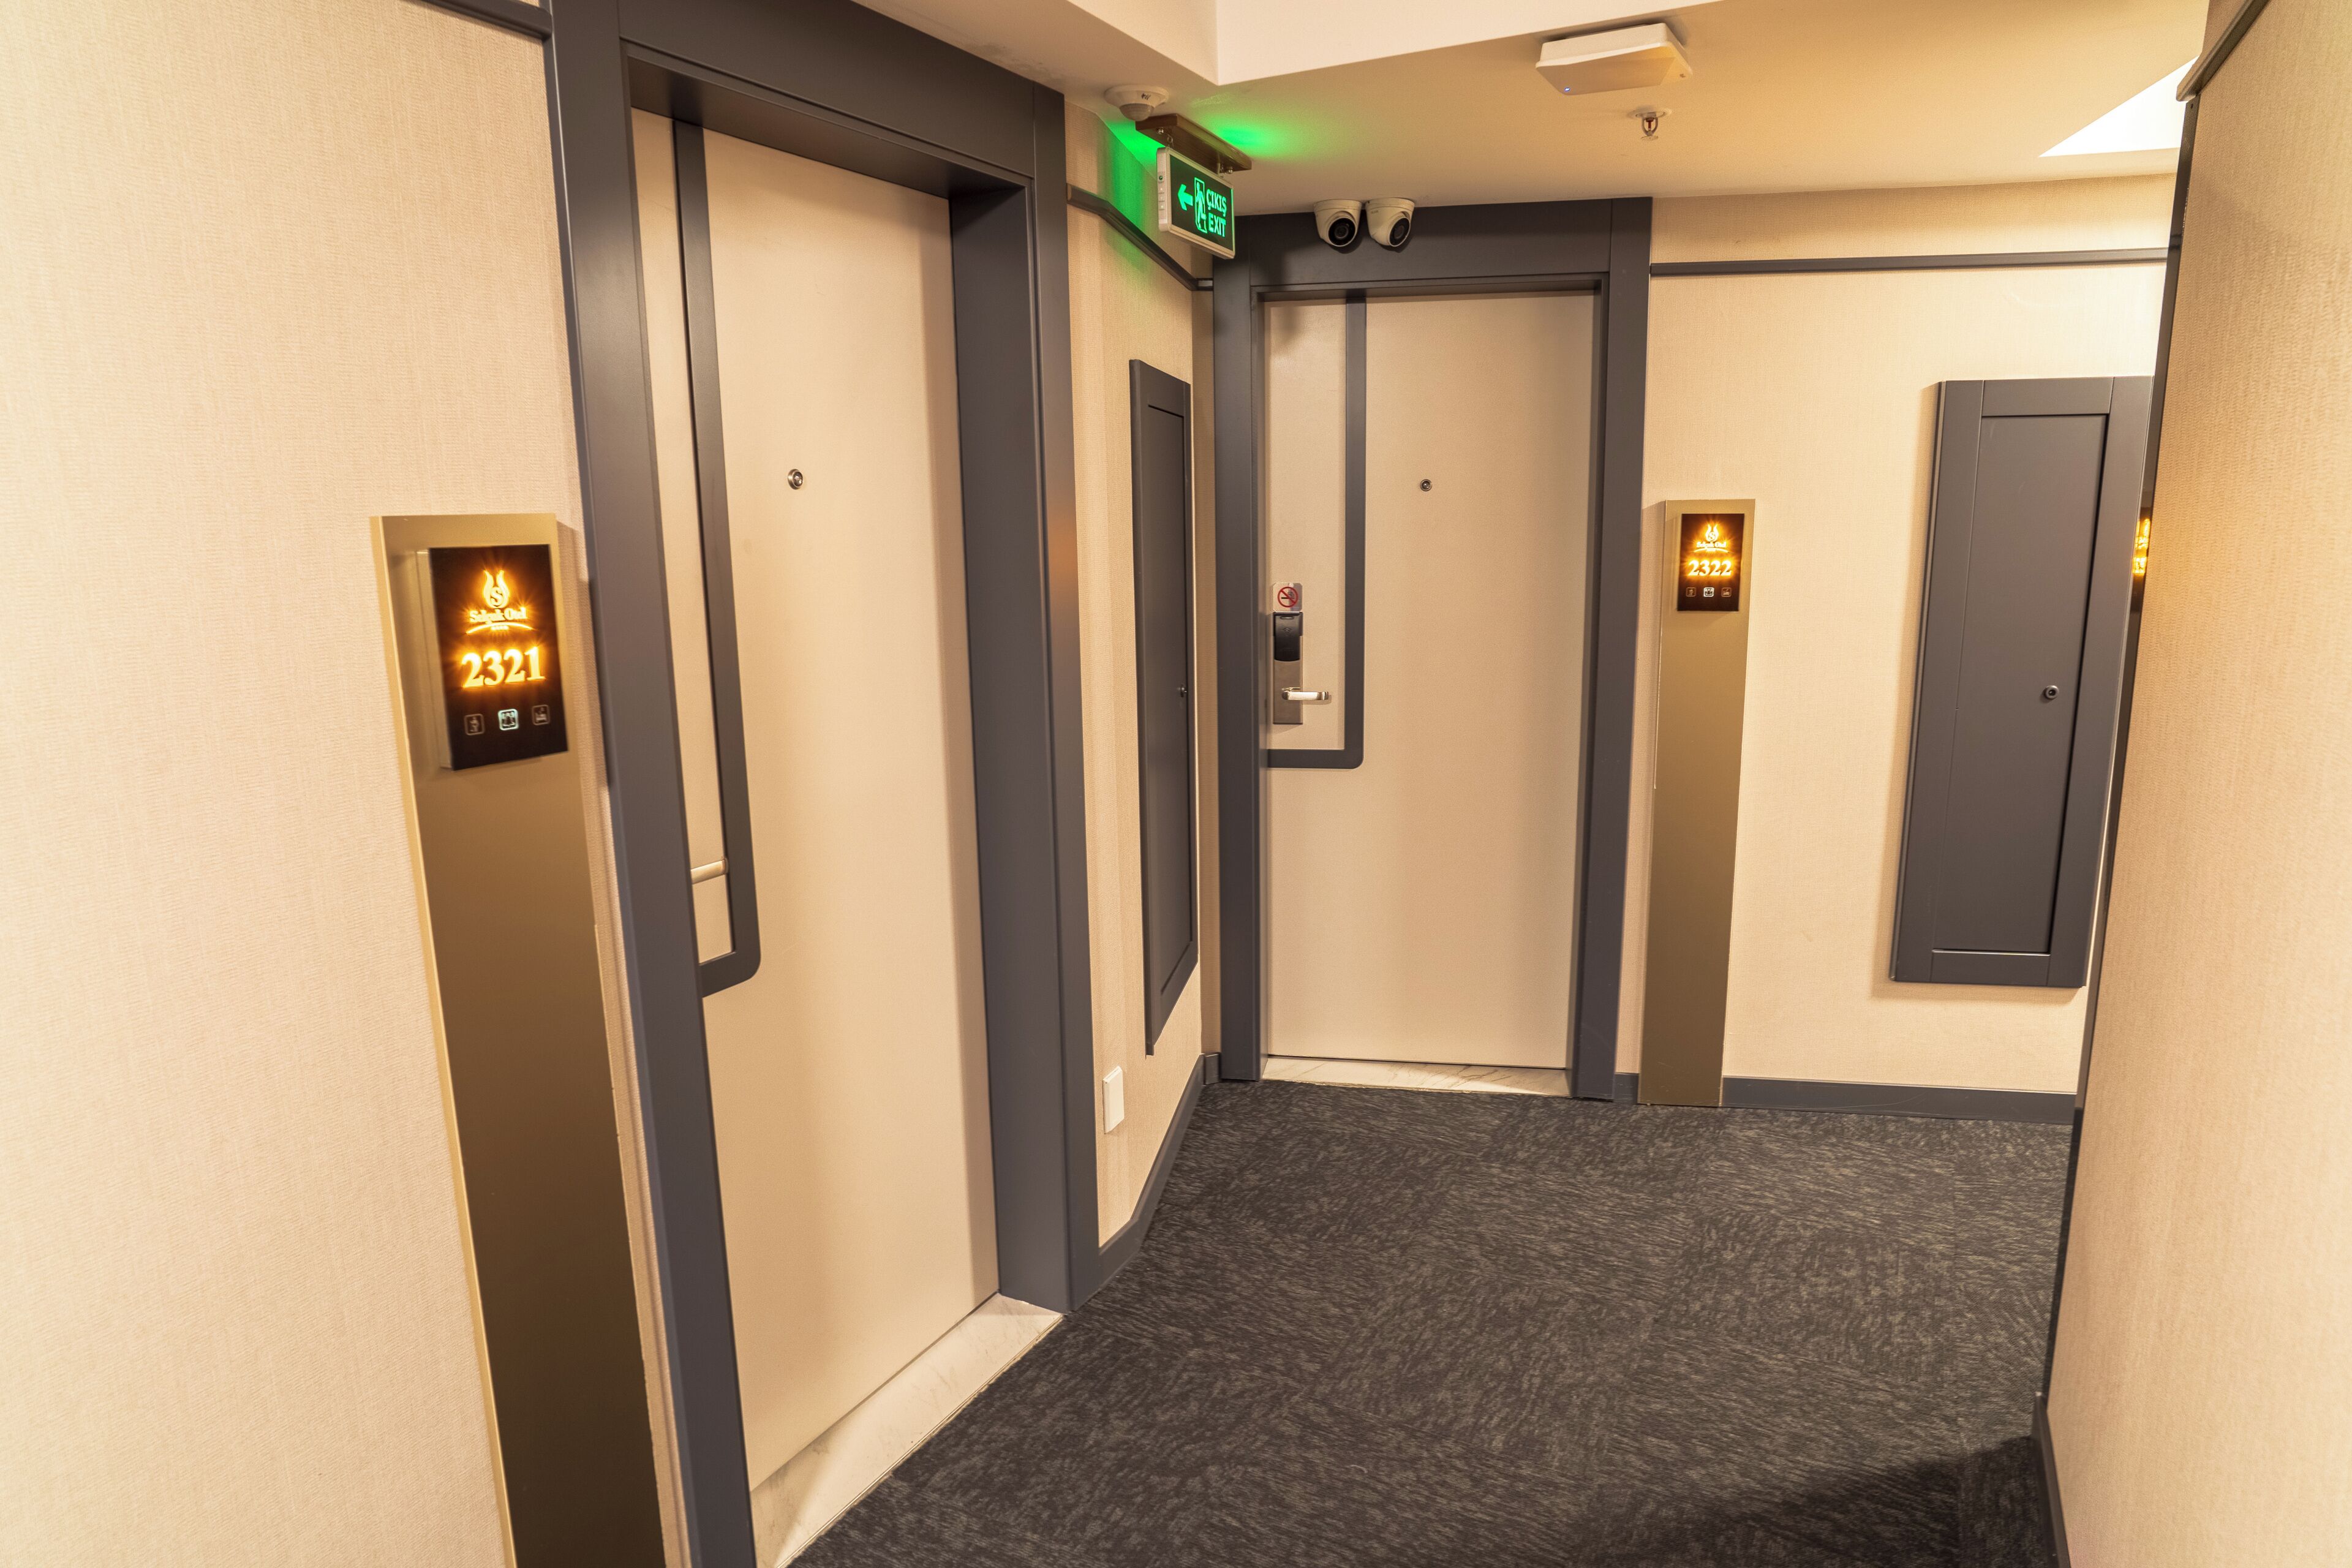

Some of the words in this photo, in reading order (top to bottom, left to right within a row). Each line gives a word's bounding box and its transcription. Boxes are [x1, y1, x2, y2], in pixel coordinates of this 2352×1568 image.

[1207, 189, 1227, 217] ÇIKIŞ
[1208, 213, 1226, 237] EXIT
[1688, 560, 1732, 576] 2322
[461, 647, 546, 688] 2321
